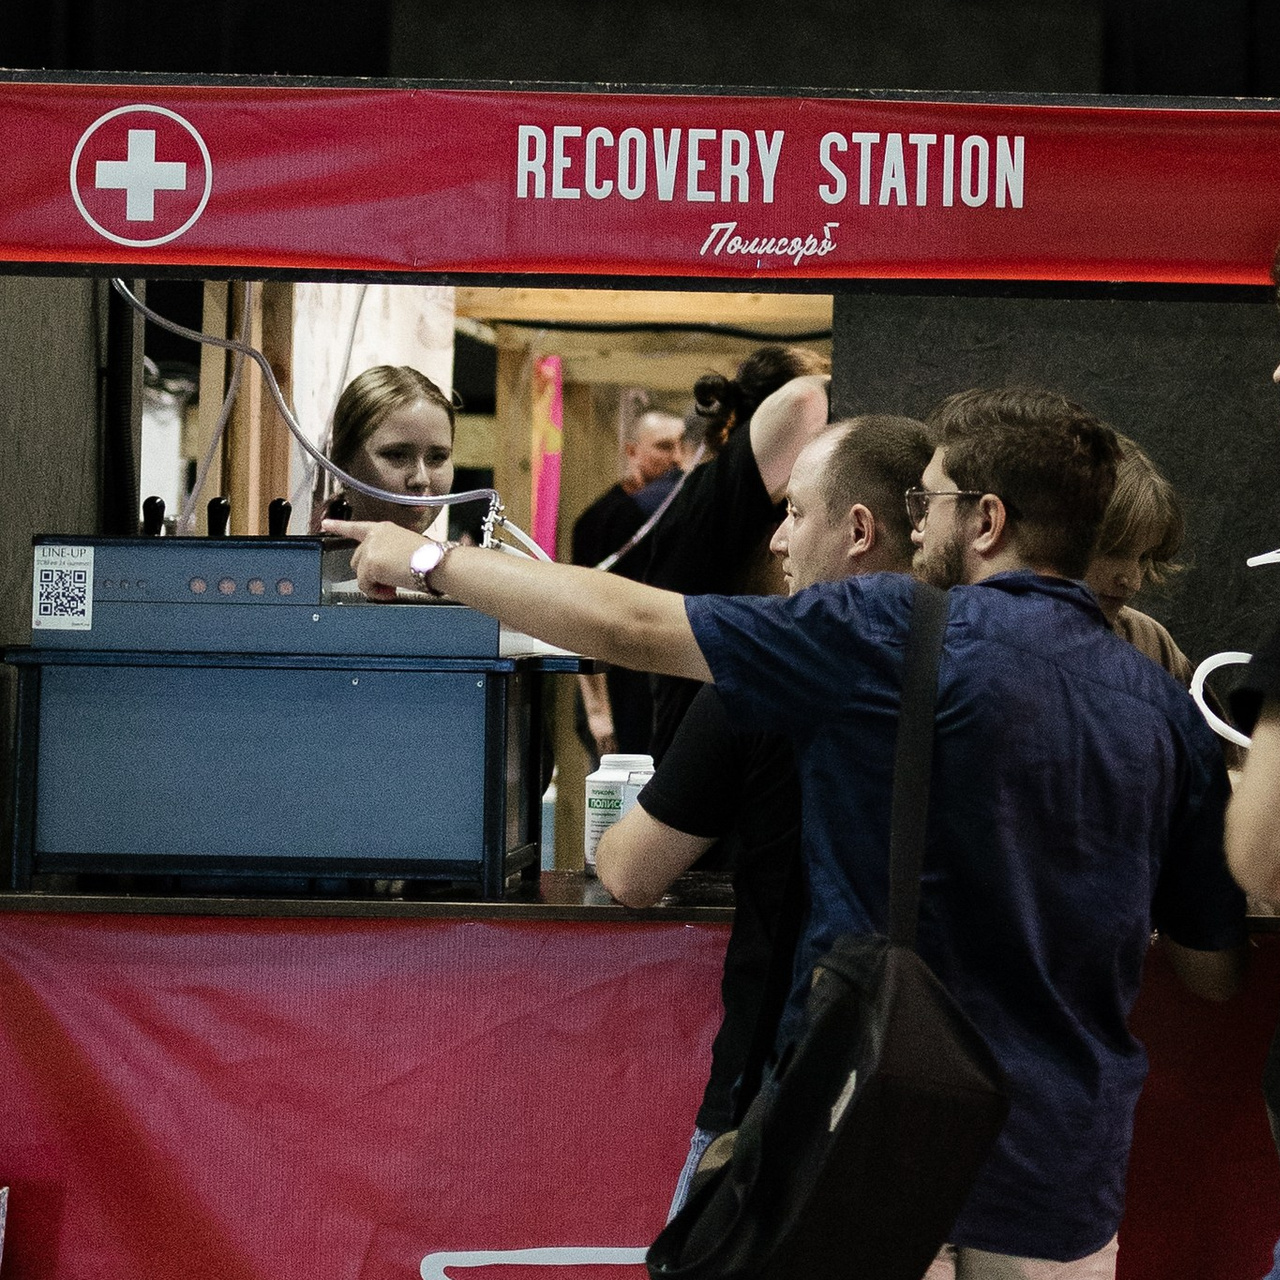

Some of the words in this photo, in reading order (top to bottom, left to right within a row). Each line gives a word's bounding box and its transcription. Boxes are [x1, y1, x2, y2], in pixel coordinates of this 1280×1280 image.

[517, 124, 785, 204] RECOVERY
[818, 131, 1026, 209] STATION
[42, 547, 87, 558] LINE-UP
[590, 799, 624, 809] ПОЛИС
